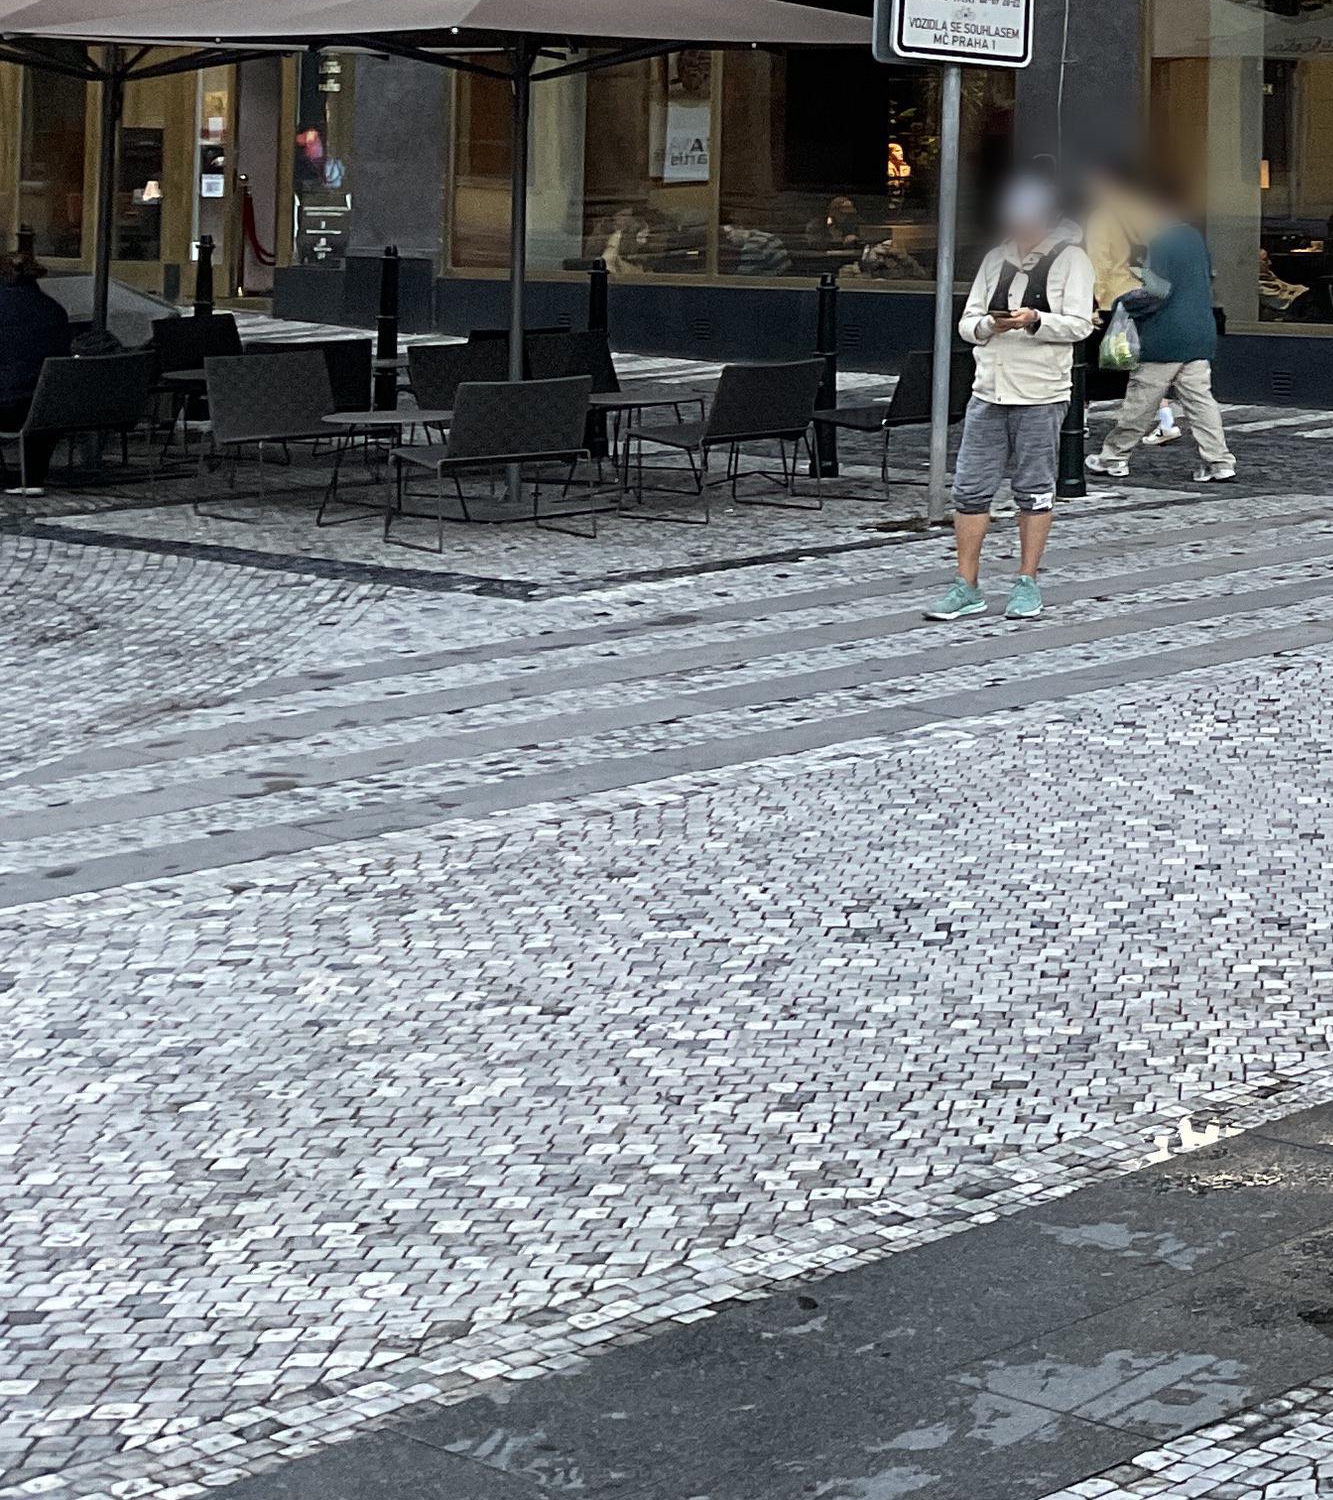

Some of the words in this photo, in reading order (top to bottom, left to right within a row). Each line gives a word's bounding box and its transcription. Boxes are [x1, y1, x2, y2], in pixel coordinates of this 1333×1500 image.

[909, 17, 948, 31] VOZIDLA
[950, 21, 962, 32] SE
[964, 24, 1020, 39] SOUHLASEM
[933, 31, 949, 45] MČ
[952, 35, 989, 49] PRAHA
